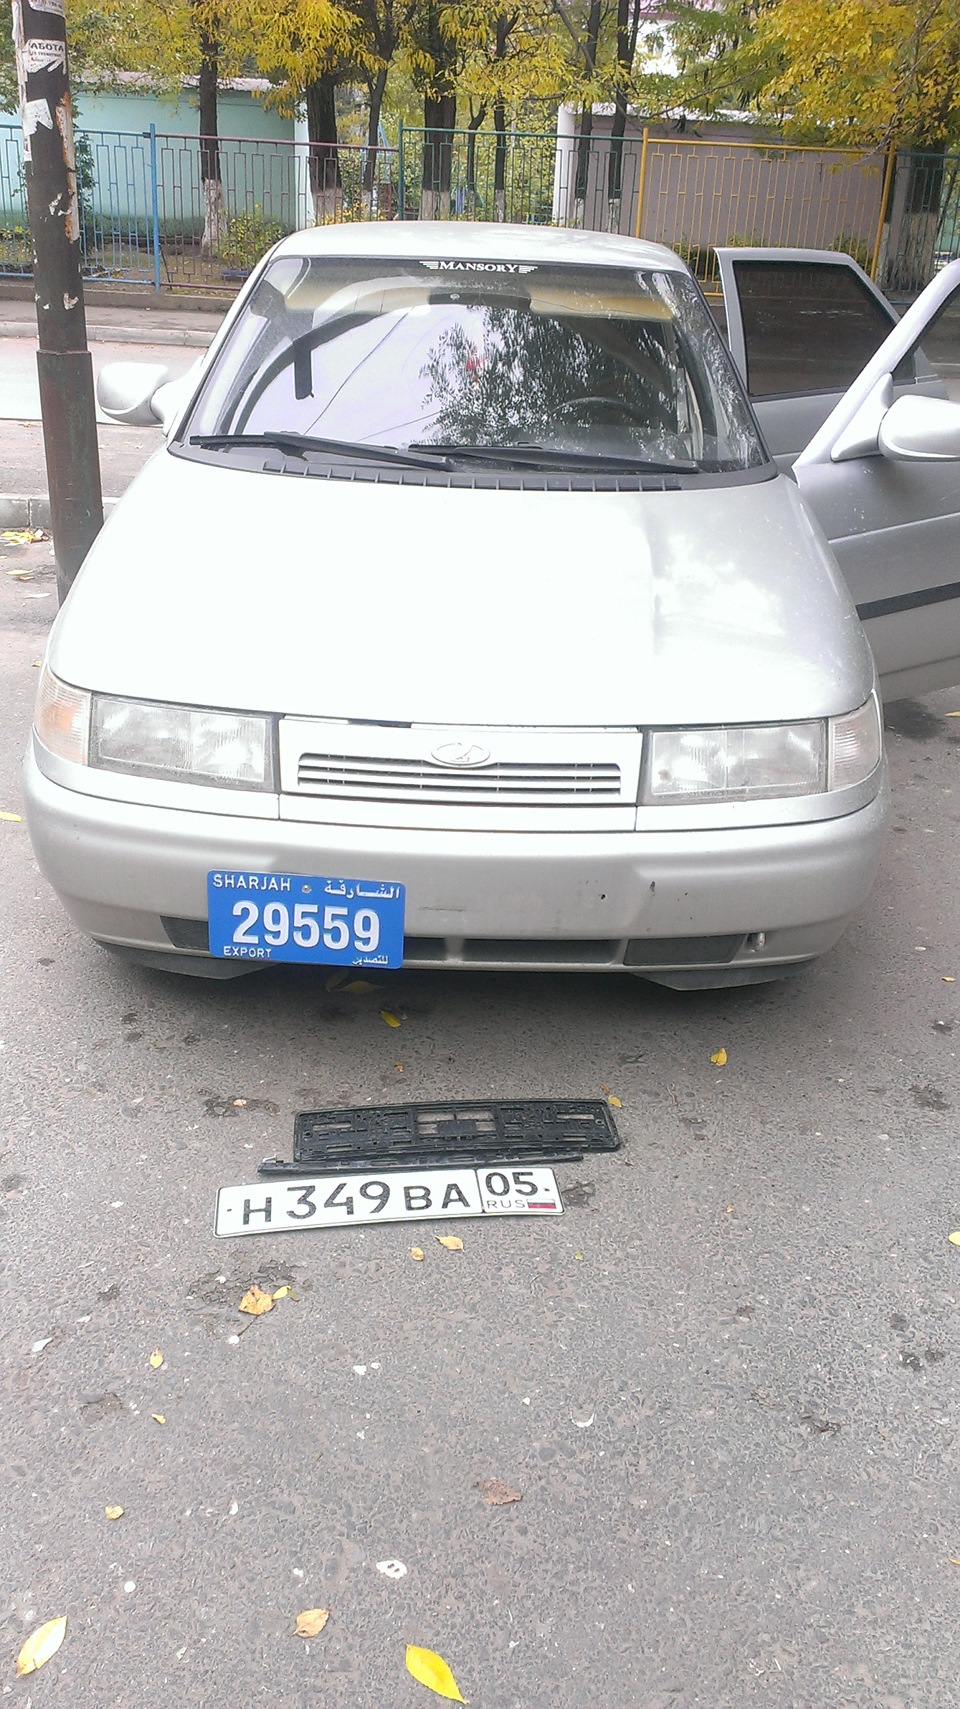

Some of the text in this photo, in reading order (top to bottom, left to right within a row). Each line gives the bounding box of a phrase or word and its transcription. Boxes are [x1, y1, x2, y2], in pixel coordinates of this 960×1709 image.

[29, 42, 64, 52] АБОТА
[439, 261, 518, 273] MANSORY
[212, 873, 291, 892] SHARJAH
[324, 880, 401, 899] الشارقة
[231, 900, 380, 953] 29559
[223, 946, 272, 958] EXPORT
[485, 1171, 538, 1197] 05
[486, 1198, 526, 1209] RUS
